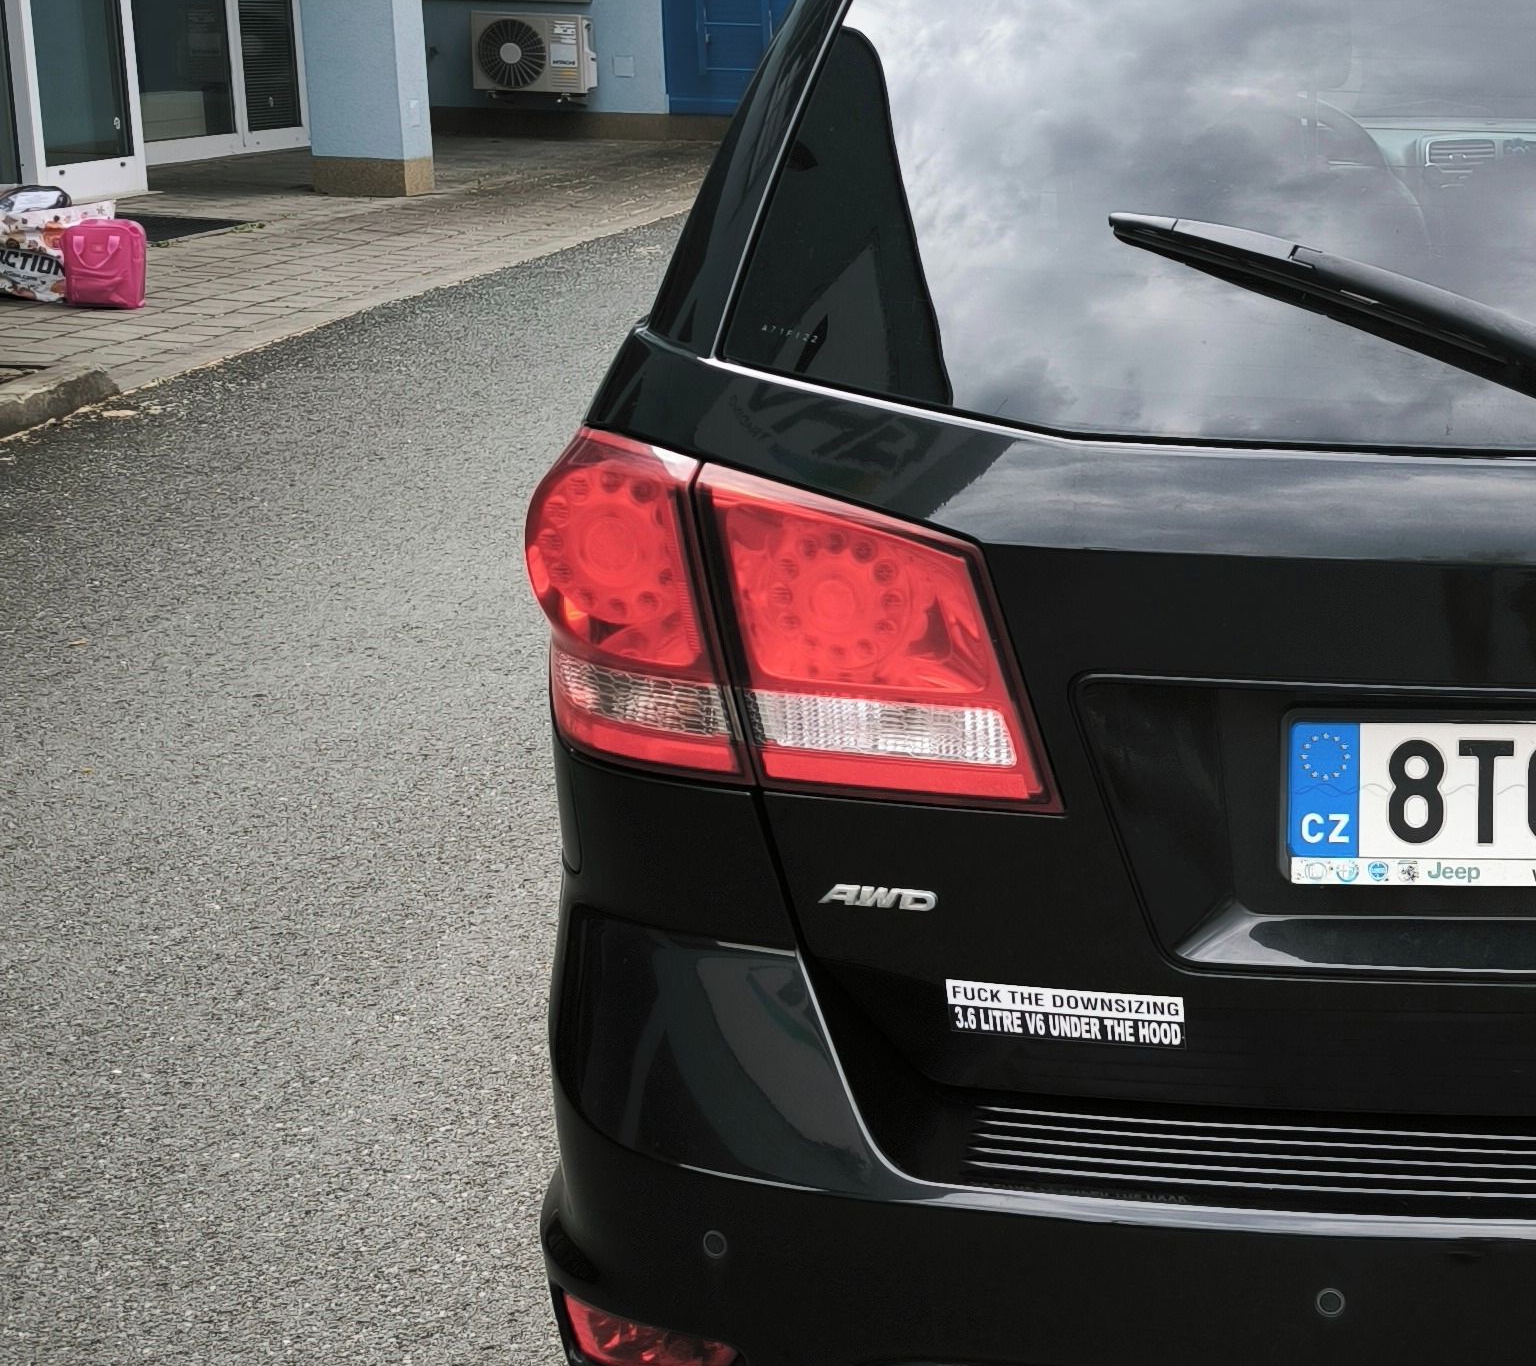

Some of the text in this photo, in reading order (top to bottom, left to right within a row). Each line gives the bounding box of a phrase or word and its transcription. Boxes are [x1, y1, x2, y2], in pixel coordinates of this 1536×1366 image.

[1301, 812, 1350, 844] CZ
[1428, 861, 1481, 883] Jeep
[817, 883, 938, 912] AWD
[952, 985, 1179, 1016] FUCK THE DOWNSIZING
[954, 1006, 1182, 1046] 3.6 LITRE V6 UNDER THE HOOD
